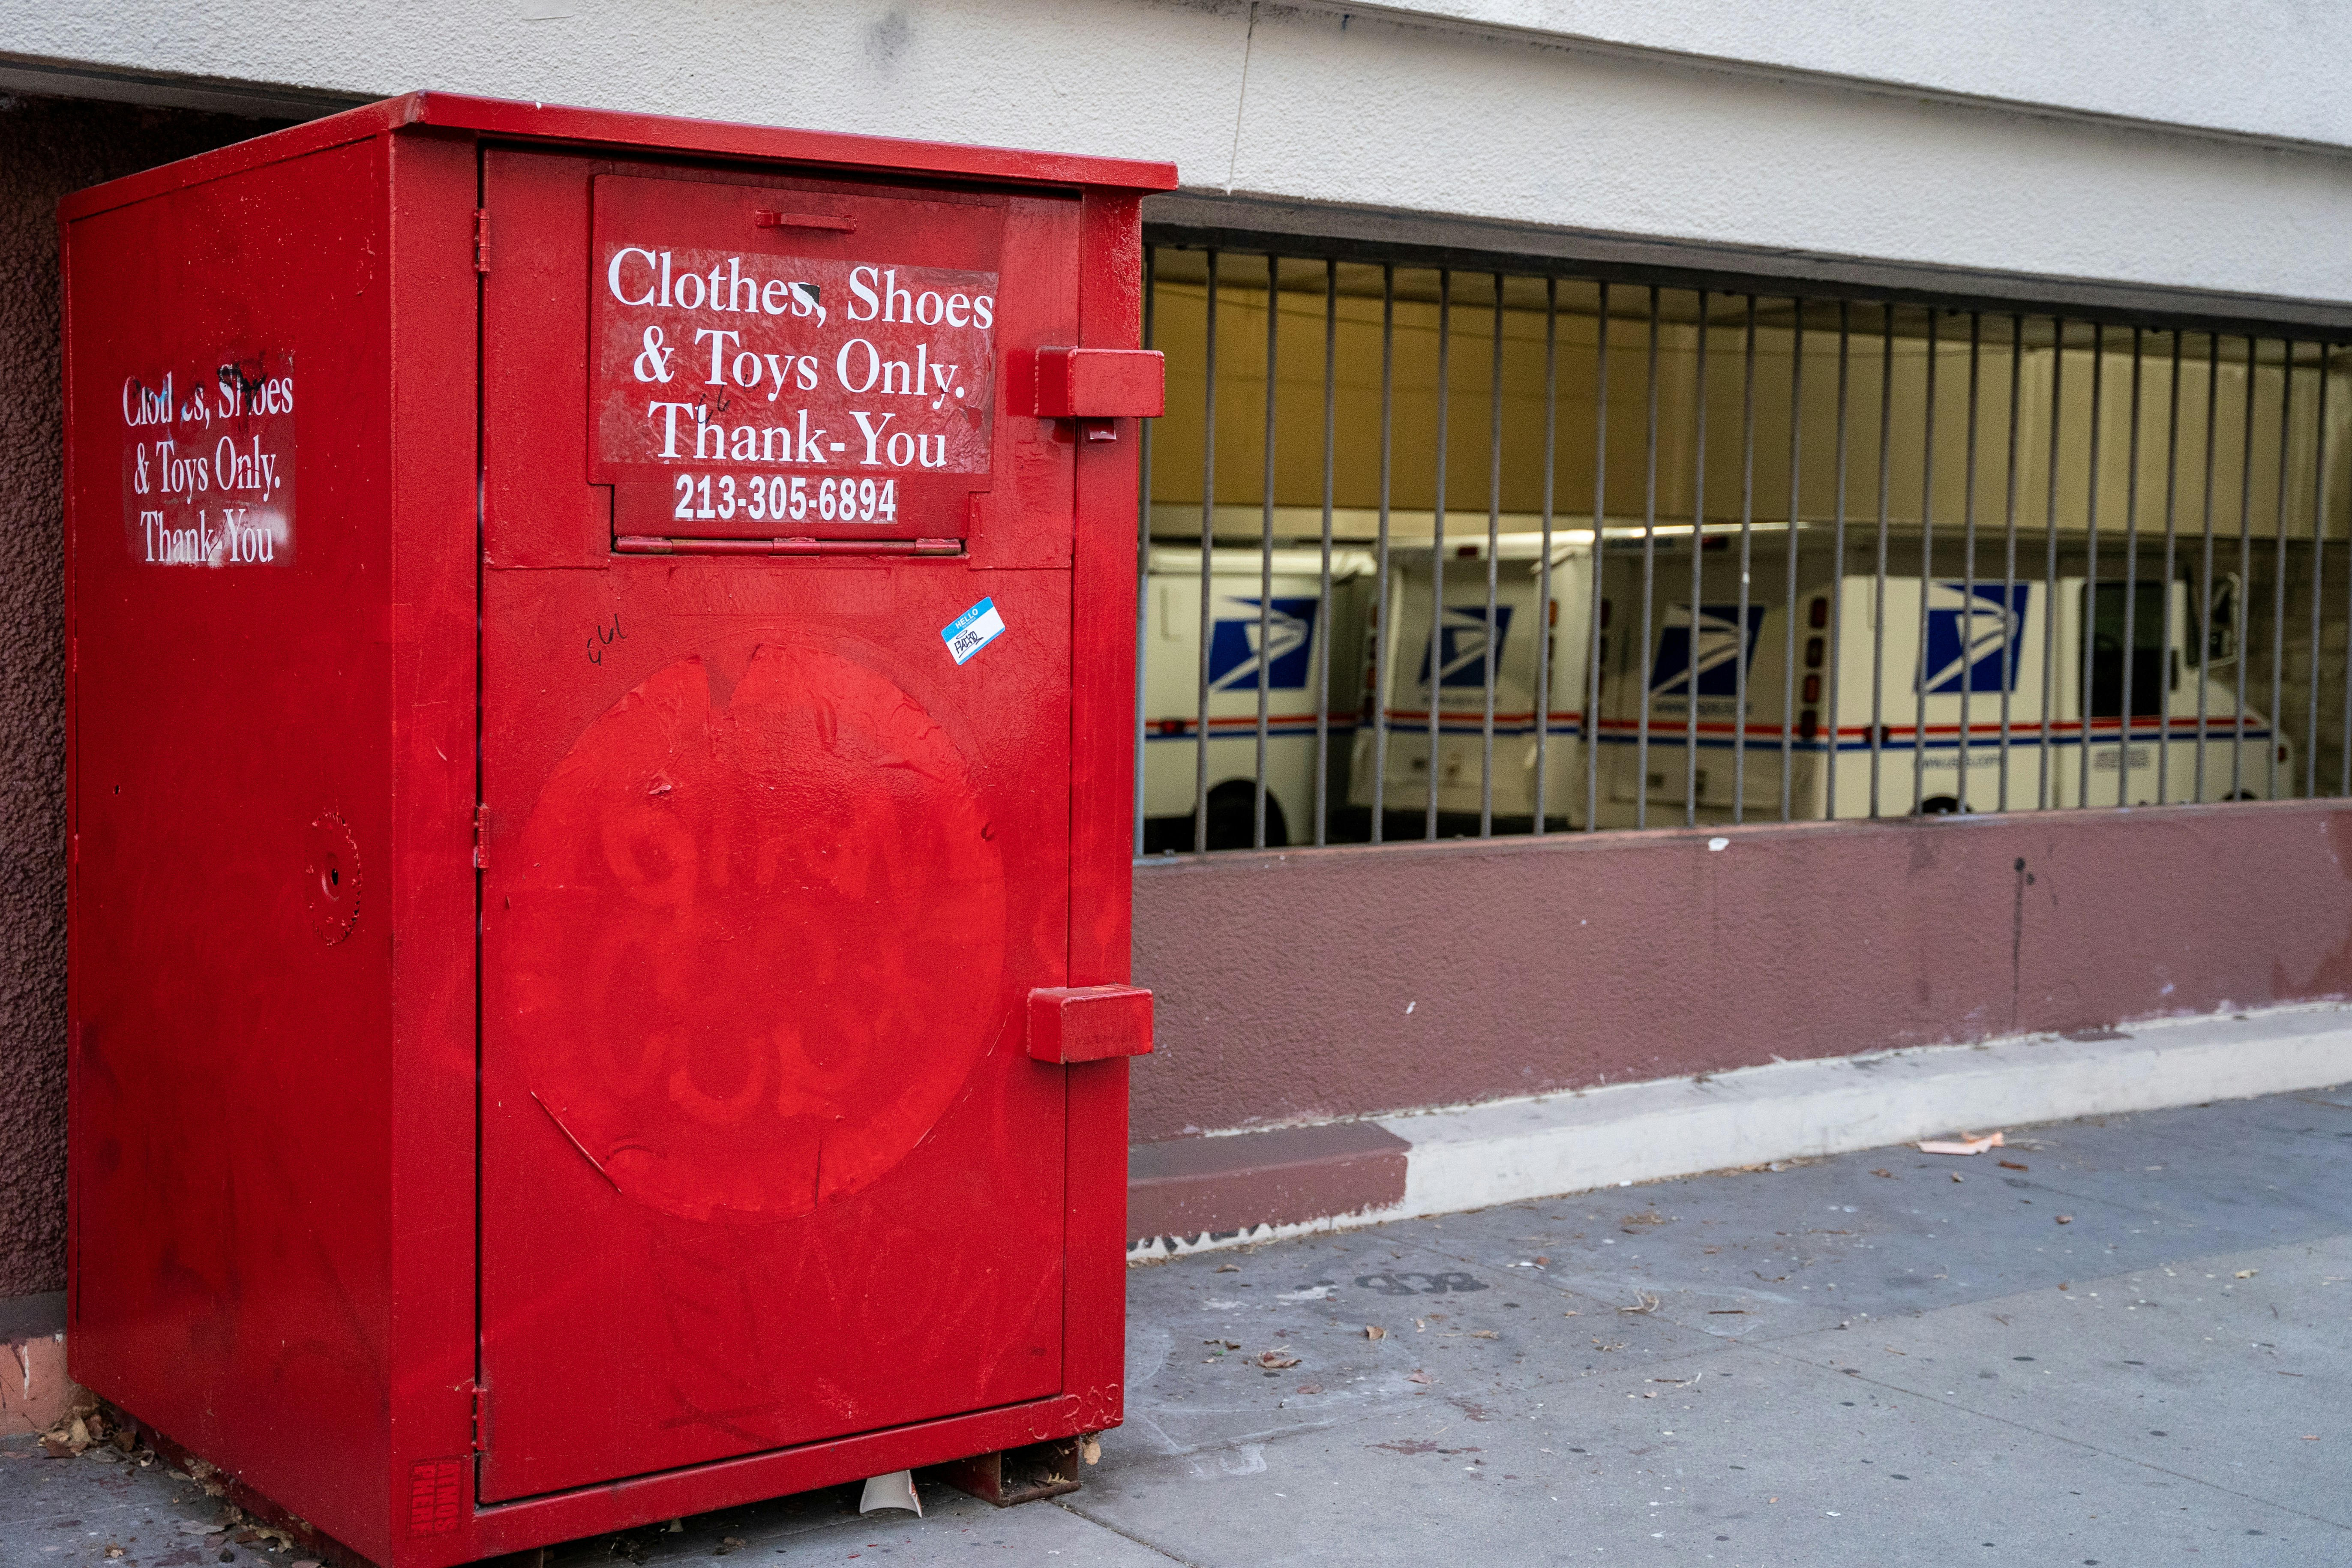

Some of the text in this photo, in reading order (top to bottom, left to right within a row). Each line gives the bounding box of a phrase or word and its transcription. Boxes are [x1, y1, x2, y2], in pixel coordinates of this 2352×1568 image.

[608, 247, 994, 329] Clothes, Shoes
[634, 325, 675, 384] &
[694, 328, 818, 401] Toys
[836, 338, 965, 409] Only.
[648, 401, 947, 468] Thank-You
[134, 434, 280, 504] & Toys Only.
[675, 474, 897, 521] 213-305-6894
[140, 508, 274, 563] Thank-You
[955, 609, 978, 629] HELLO
